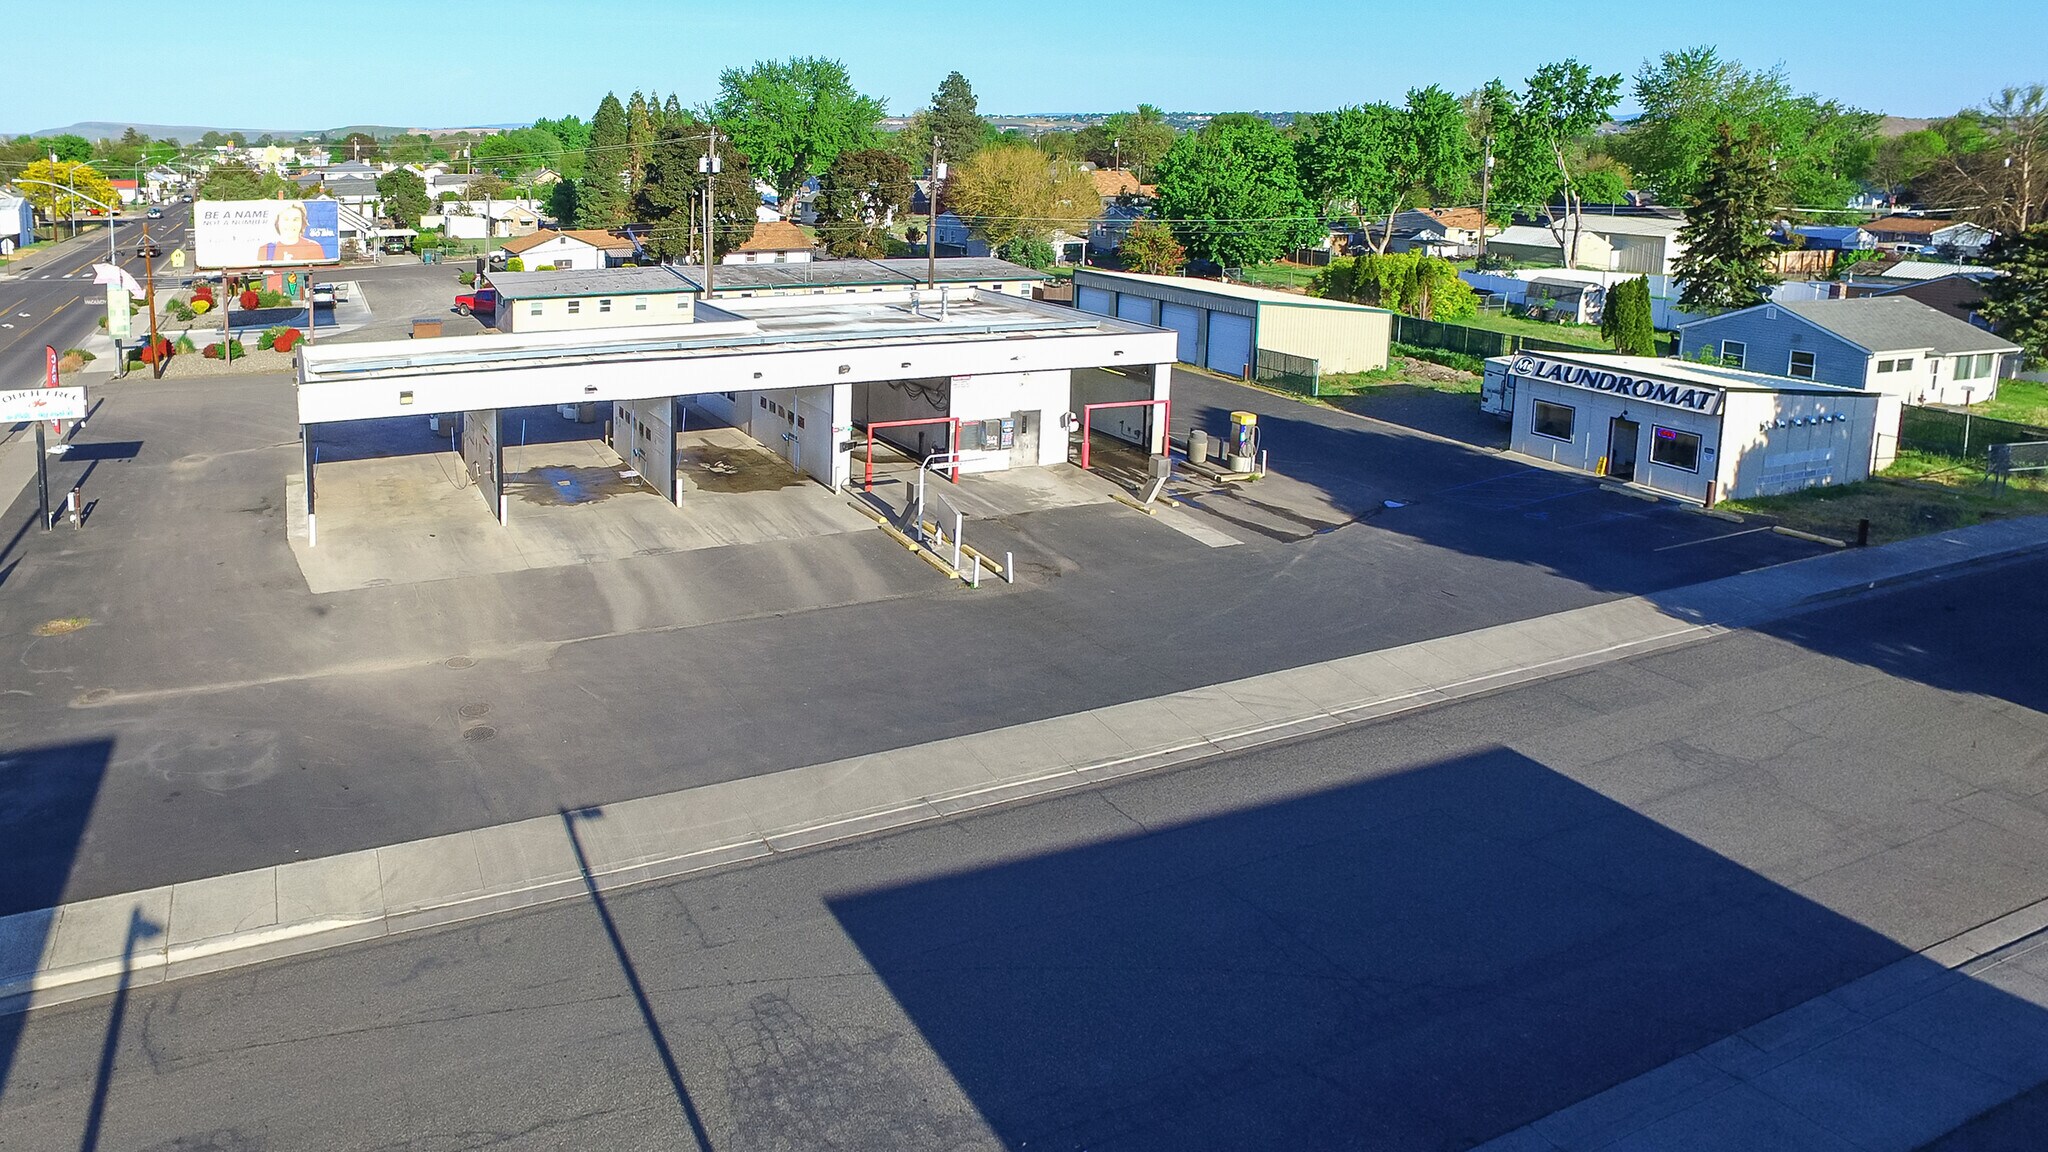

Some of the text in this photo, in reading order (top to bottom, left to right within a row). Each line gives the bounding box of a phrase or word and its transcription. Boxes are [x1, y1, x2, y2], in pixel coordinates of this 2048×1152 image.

[204, 210, 269, 219] BE A NAME
[1534, 361, 1716, 410] LAUNDROMAT
[0, 390, 40, 403] OUCH
